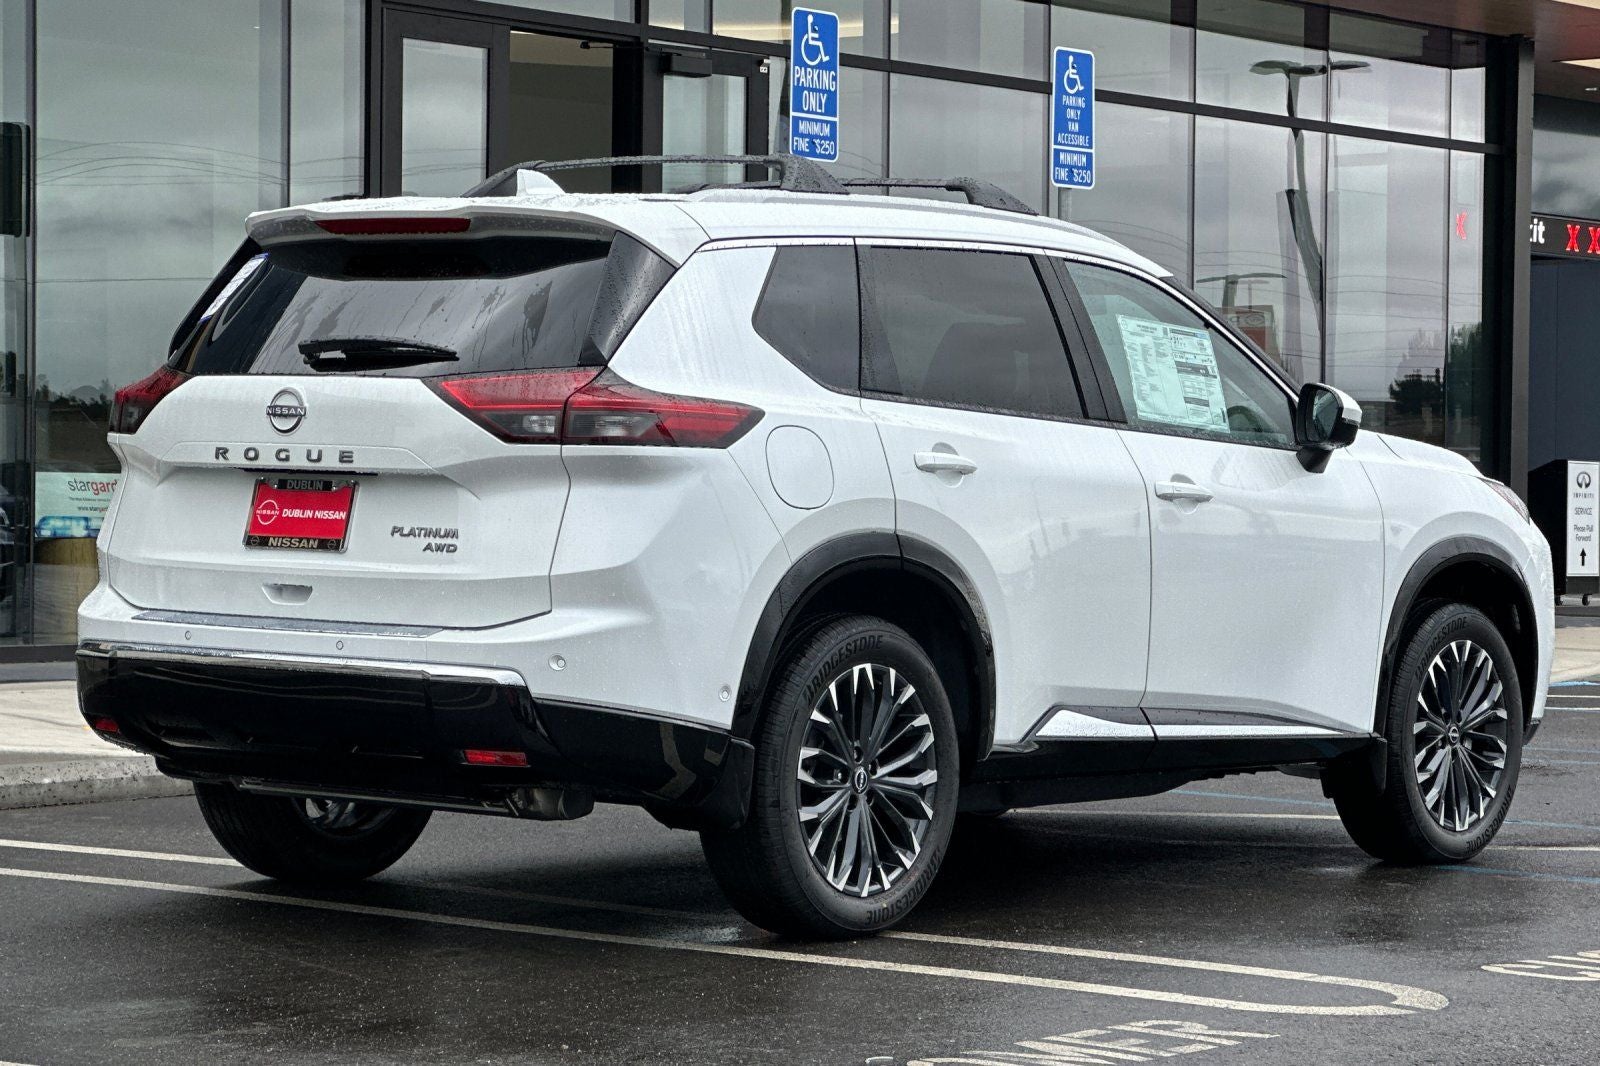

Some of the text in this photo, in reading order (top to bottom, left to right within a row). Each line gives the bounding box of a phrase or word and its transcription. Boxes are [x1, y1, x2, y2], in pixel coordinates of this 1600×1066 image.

[794, 66, 836, 92] PARKING
[802, 90, 827, 113] ONLY
[1062, 95, 1086, 108] PARKING
[1066, 108, 1081, 120] ONLY
[799, 120, 830, 137] MINIMUM
[1068, 121, 1079, 132] VAN
[793, 137, 835, 155] FINE $250
[1057, 132, 1090, 147] ACCESSIBLE
[1060, 151, 1087, 167] MINIMUM
[1055, 167, 1092, 184] FINE $250
[266, 405, 306, 416] NISSAN
[214, 446, 355, 464] ROGUE
[286, 480, 324, 491] DUBLIN
[282, 508, 347, 520] DUBLIN NISSAN
[1574, 507, 1593, 515] SERVICE
[390, 526, 459, 539] PLATINUM
[268, 537, 319, 549] NISSAN
[422, 542, 458, 553] AWD
[803, 634, 884, 707] BRIDGESTONE
